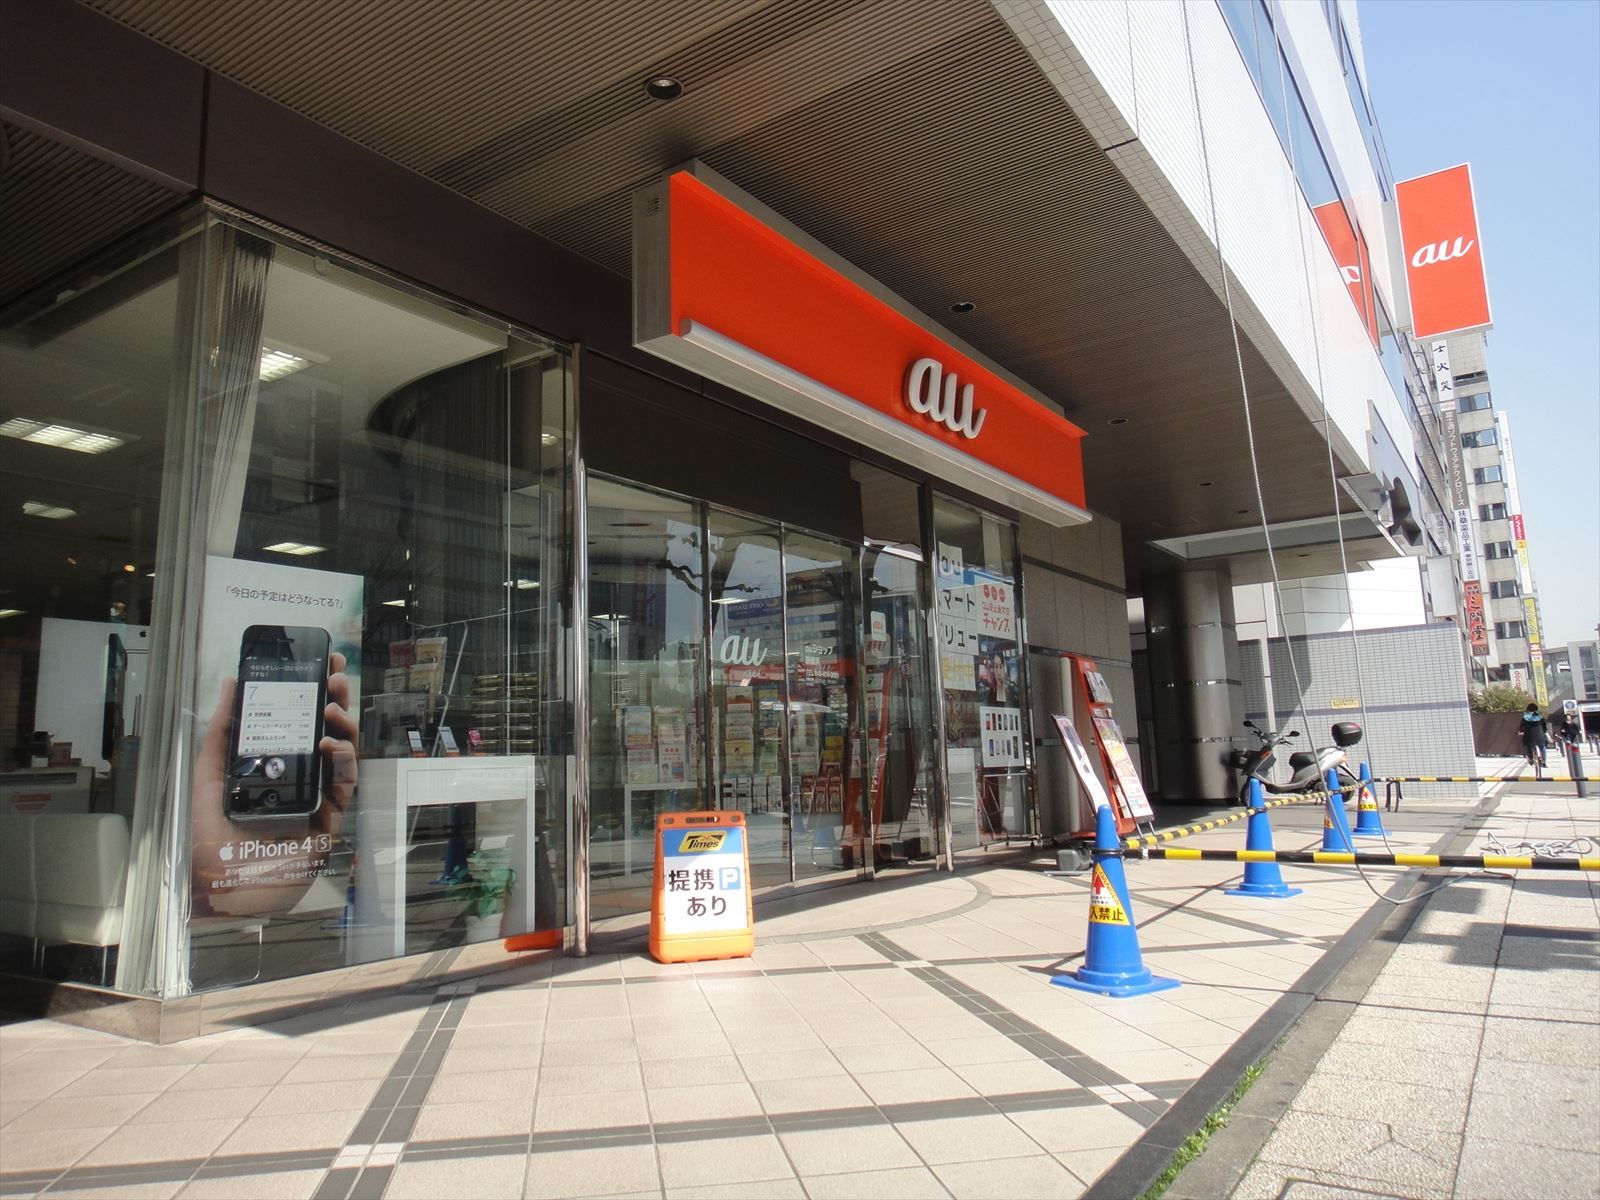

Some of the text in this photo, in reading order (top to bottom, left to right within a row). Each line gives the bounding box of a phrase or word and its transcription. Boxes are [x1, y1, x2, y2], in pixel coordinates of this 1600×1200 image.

[1412, 235, 1475, 269] au
[907, 357, 987, 440] au
[940, 555, 961, 577] au
[983, 612, 1011, 632] チャンス
[940, 623, 977, 648] リュー
[720, 635, 768, 666] au
[249, 686, 258, 700] 7
[239, 839, 299, 860] iPhone
[687, 838, 719, 850] Times
[668, 868, 715, 892] 提携
[687, 895, 727, 917] あり
